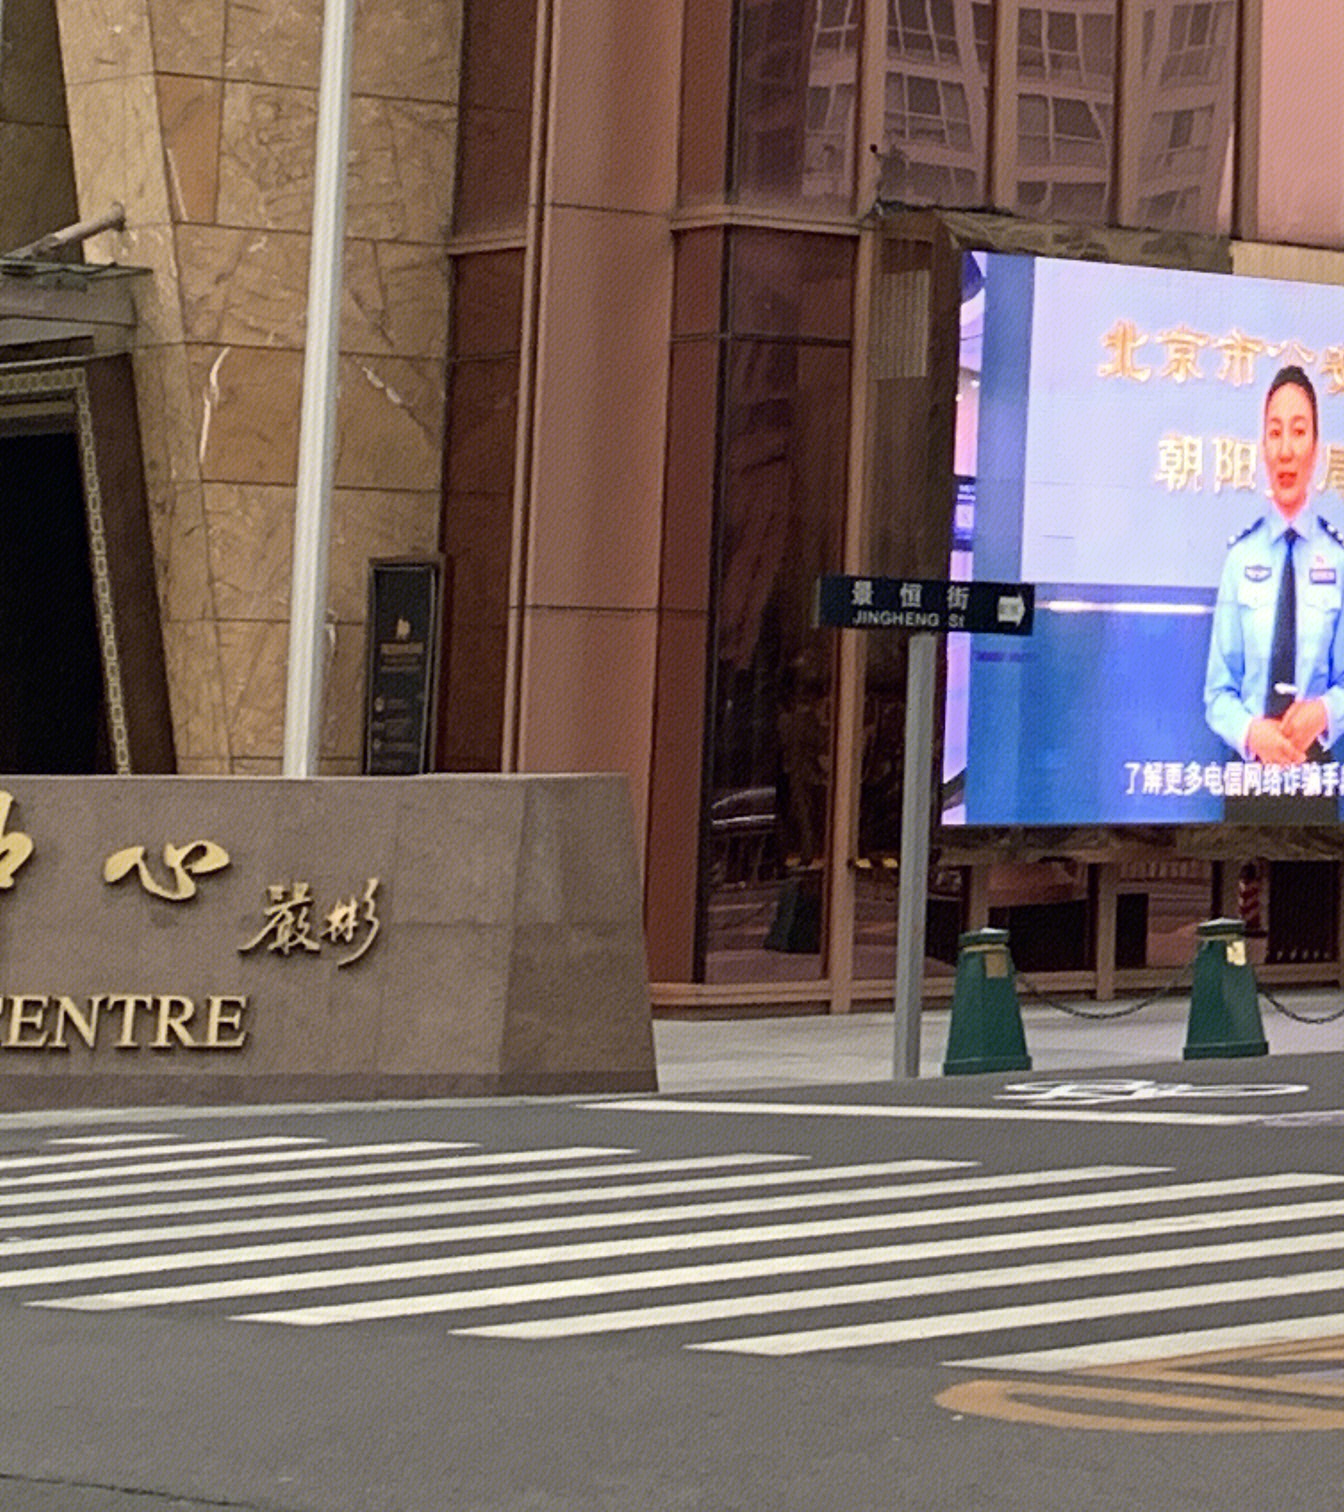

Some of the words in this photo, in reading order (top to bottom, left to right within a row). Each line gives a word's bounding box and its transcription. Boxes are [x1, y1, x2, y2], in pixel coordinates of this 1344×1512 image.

[853, 610, 940, 627] JINGHENG
[948, 614, 965, 628] St
[0, 994, 250, 1049] ENTRE
